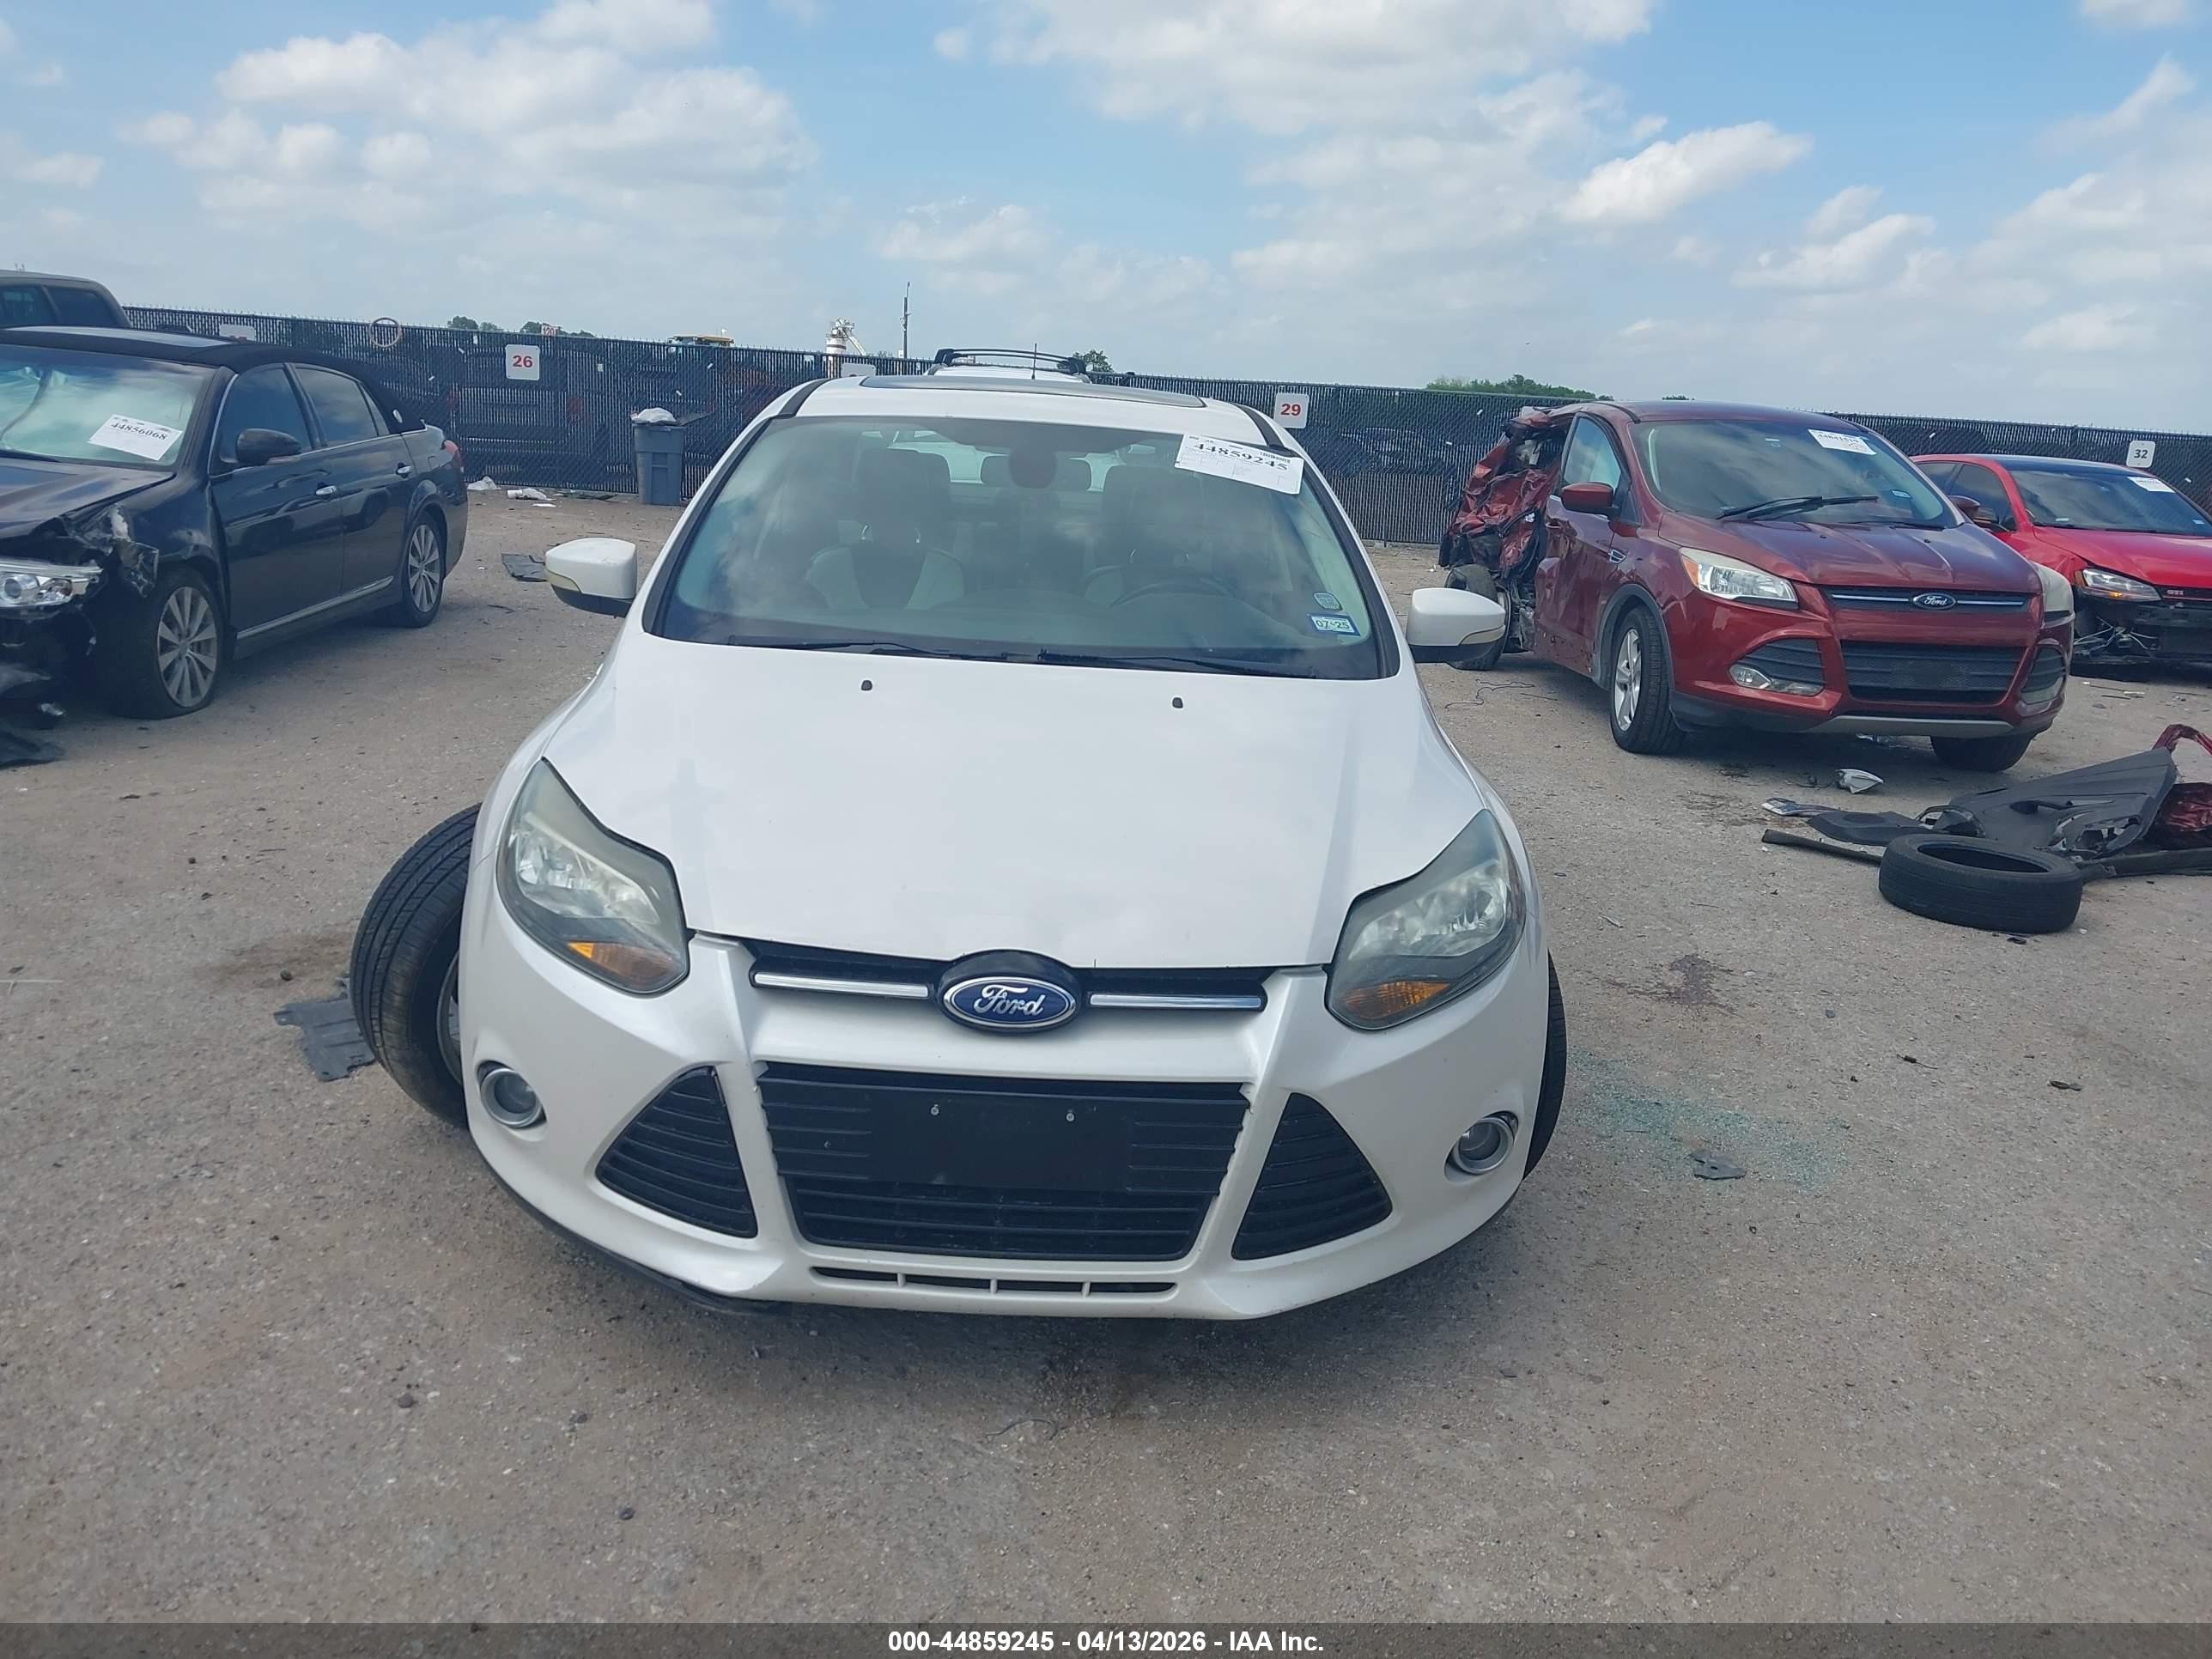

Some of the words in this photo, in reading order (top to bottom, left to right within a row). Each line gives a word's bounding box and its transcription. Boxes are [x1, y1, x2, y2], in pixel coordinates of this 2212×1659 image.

[513, 356, 533, 368] 26
[1280, 404, 1301, 416] 29
[111, 422, 167, 440] 44856068
[1193, 443, 1288, 471] 44859245
[2134, 449, 2148, 459] 32
[1923, 595, 1948, 605] Ford
[973, 984, 1046, 1016] Ford
